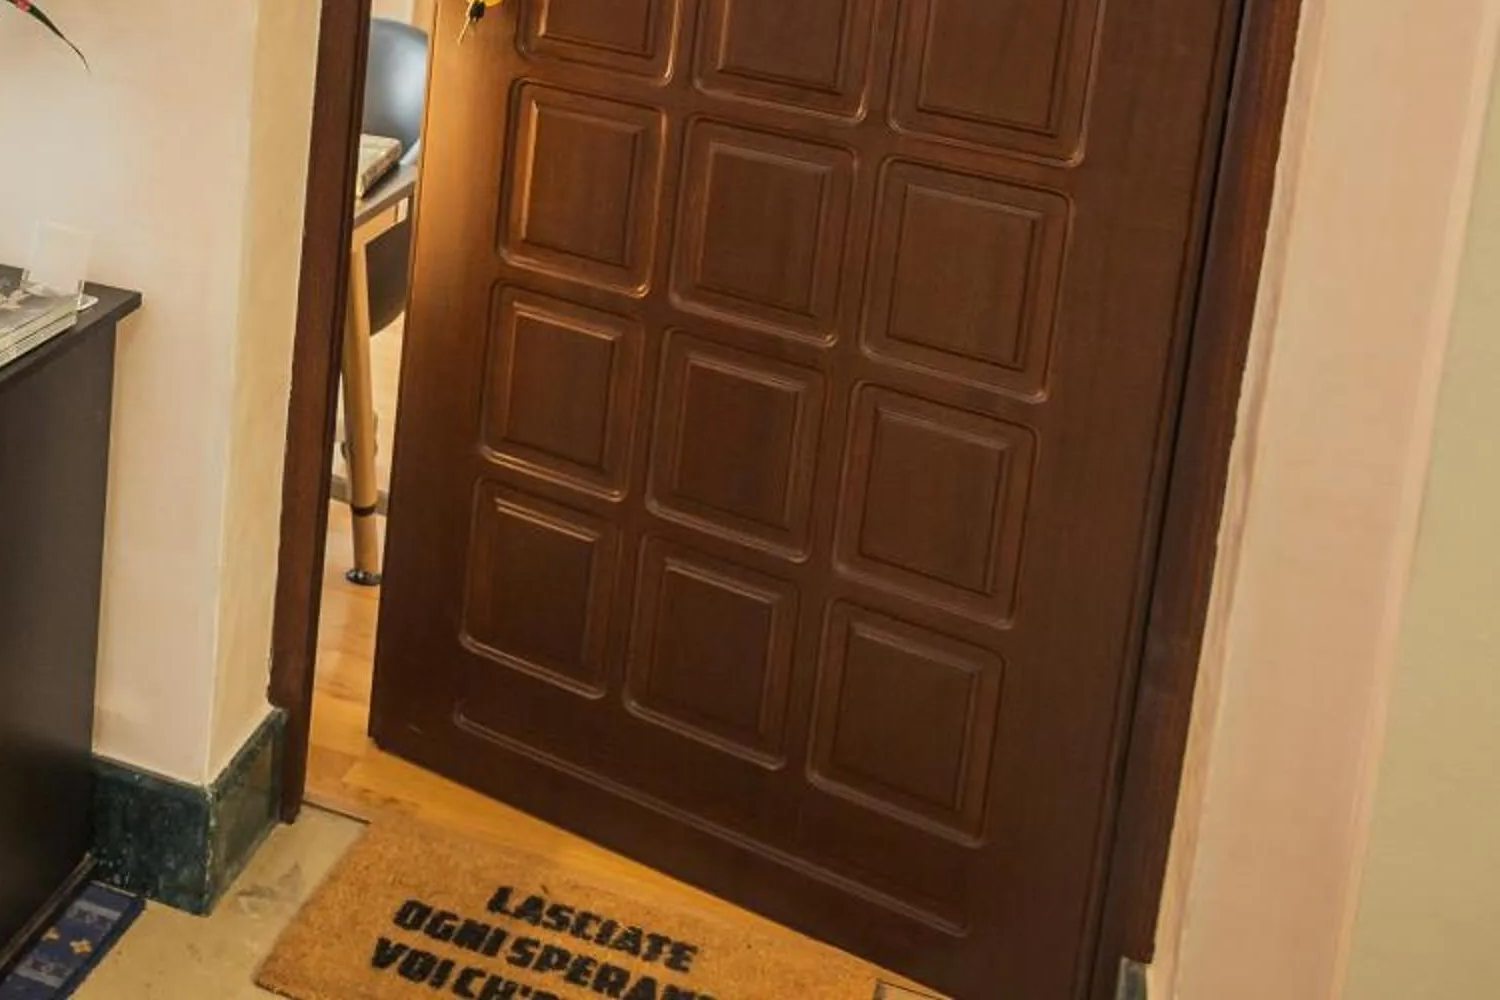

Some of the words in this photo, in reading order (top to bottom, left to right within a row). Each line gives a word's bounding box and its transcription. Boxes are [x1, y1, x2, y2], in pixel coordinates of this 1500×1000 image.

[393, 899, 509, 957] OGNI
[486, 885, 699, 974] LASCIATE
[371, 936, 456, 989] VOI
